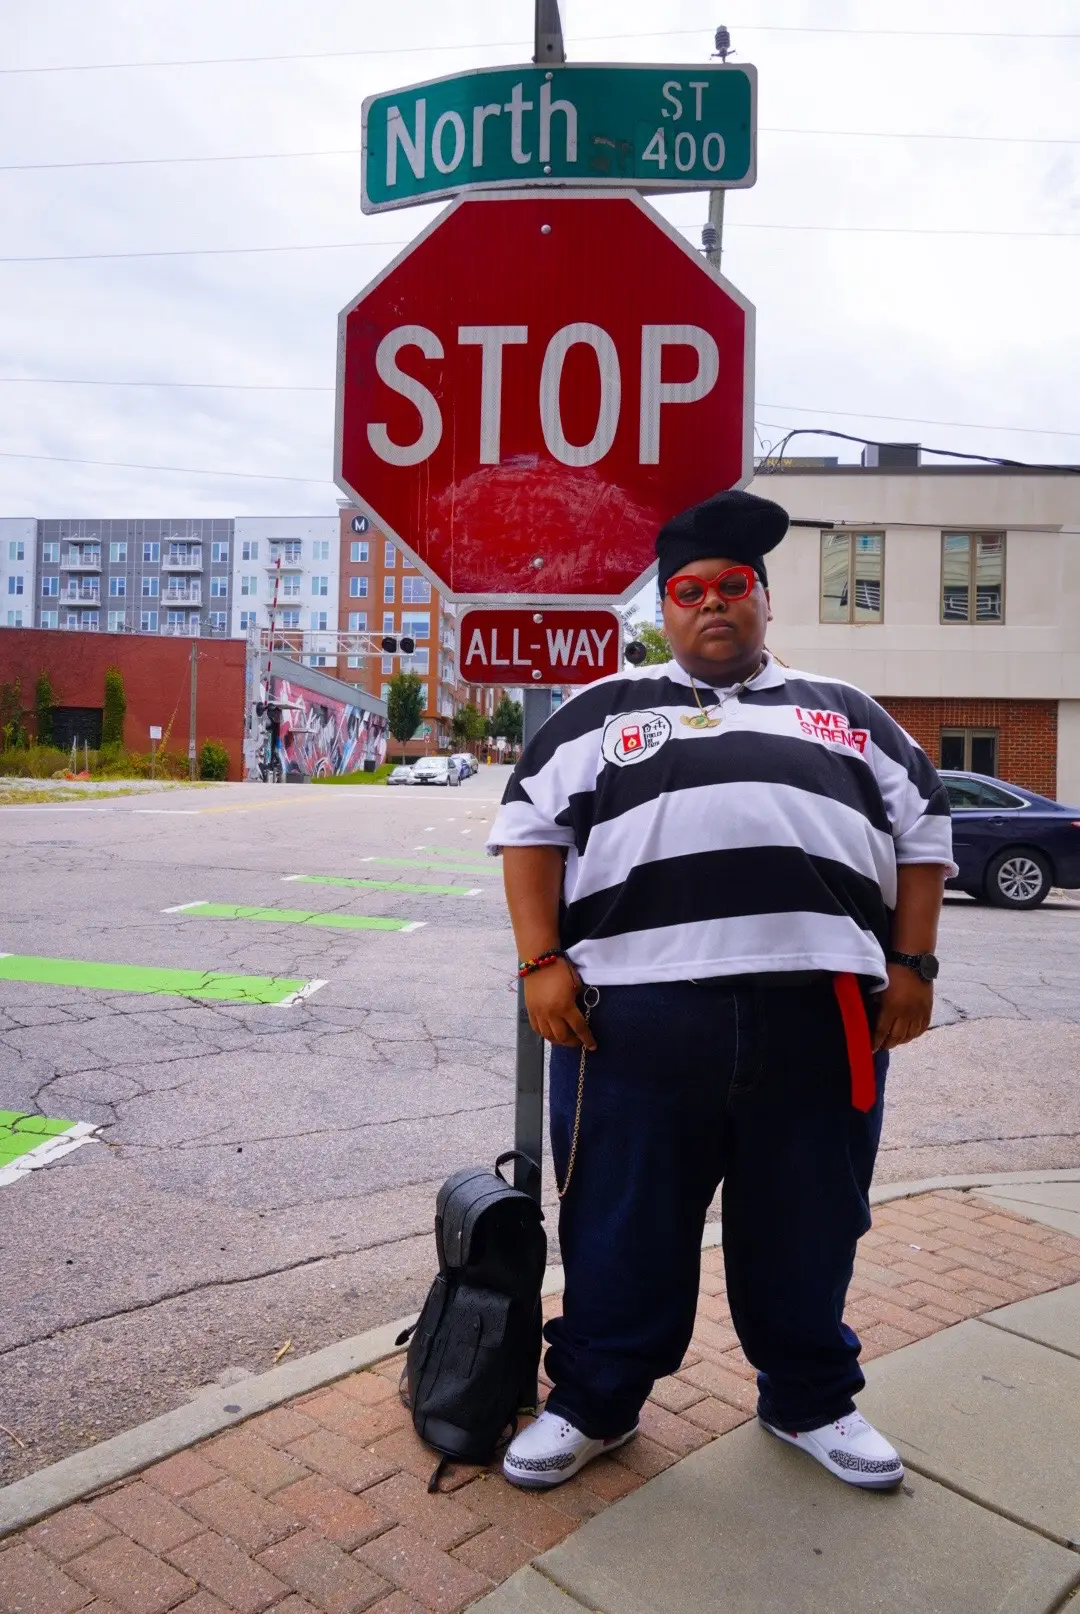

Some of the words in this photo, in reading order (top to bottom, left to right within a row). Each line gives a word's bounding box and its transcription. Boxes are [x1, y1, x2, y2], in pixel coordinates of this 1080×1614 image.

[661, 81, 709, 121] ST
[386, 82, 578, 186] North
[642, 127, 726, 172] 400
[366, 322, 720, 467] STOP
[354, 519, 365, 531] M
[464, 628, 614, 667] ALL-WAY
[795, 708, 803, 720] I
